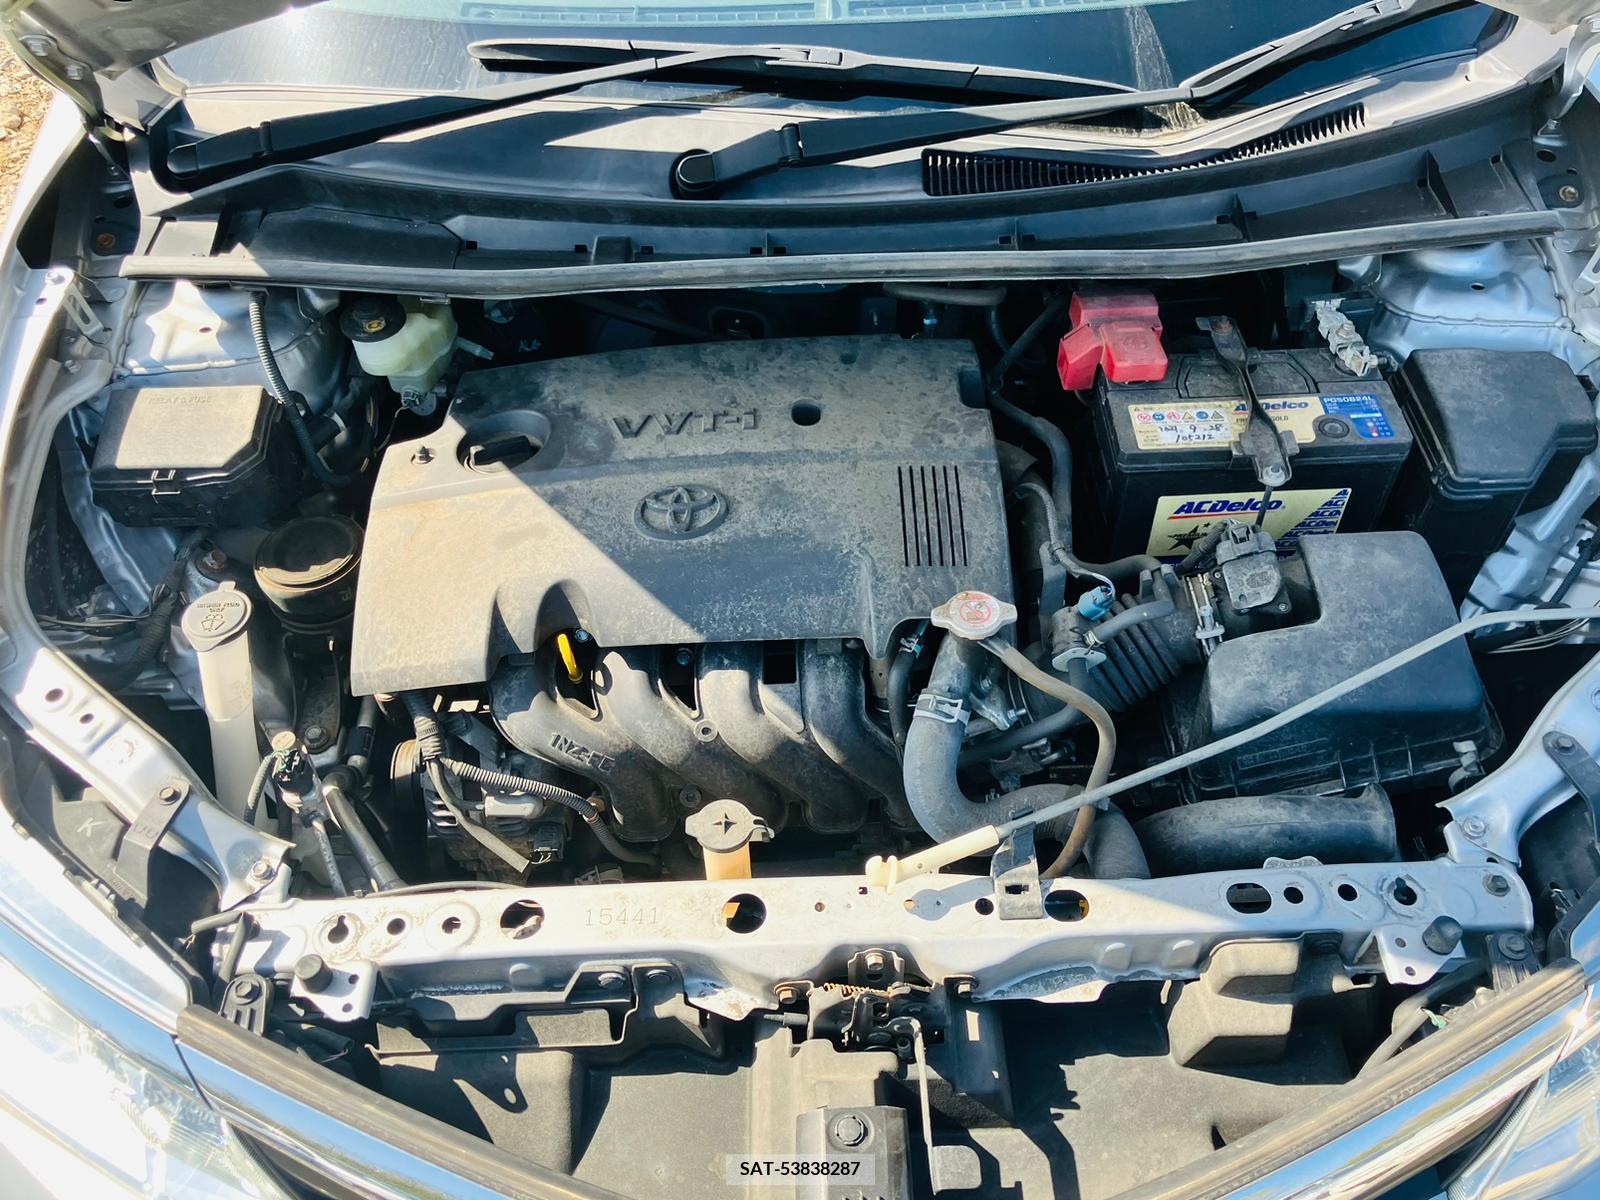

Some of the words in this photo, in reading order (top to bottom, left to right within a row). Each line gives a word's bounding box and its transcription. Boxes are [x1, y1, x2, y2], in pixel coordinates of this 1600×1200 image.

[1233, 401, 1309, 411] ADelco
[1173, 498, 1283, 515] ACDelco
[585, 906, 659, 927] 15441
